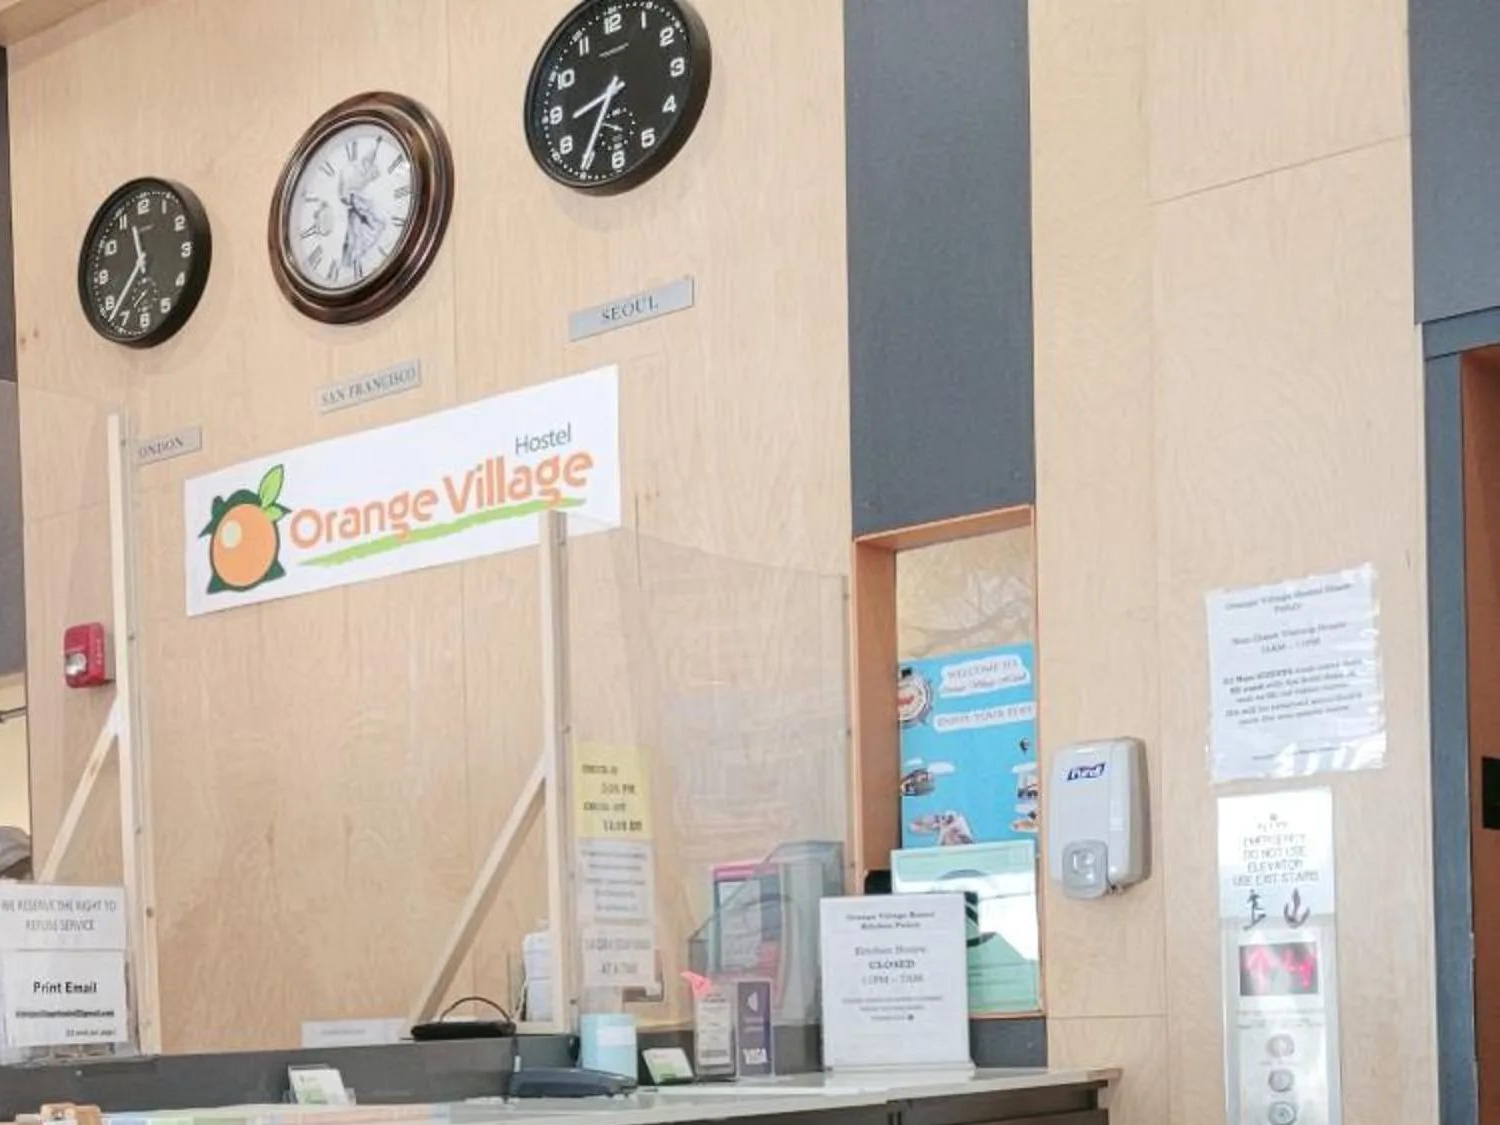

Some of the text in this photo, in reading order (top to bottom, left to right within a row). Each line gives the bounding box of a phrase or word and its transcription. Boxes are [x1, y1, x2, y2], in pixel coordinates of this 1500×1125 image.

[604, 13, 623, 35] 12
[641, 11, 647, 30] 1
[659, 26, 675, 47] 2
[579, 36, 590, 57] 11
[670, 57, 685, 77] 3
[557, 68, 575, 90] 10
[662, 95, 677, 113] 4
[550, 106, 563, 125] 9
[560, 136, 573, 154] 8
[641, 128, 655, 148] 5
[611, 151, 625, 169] 6
[137, 198, 150, 215] 12
[161, 199, 167, 214] 1
[119, 214, 128, 230] 11
[174, 214, 186, 232] 2
[104, 239, 117, 256] 10
[180, 241, 192, 258] 3
[99, 269, 109, 285] 9
[175, 272, 185, 287] 4
[104, 295, 115, 311] 8
[160, 297, 171, 314] 5
[601, 294, 659, 321] SEOUL
[119, 309, 130, 326] 7
[140, 313, 150, 328] 6
[320, 366, 417, 406] SAN FRANCISCO
[137, 434, 184, 457] ONDON
[514, 422, 573, 456] Hostel
[289, 450, 594, 550] Orange Village
[59, 919, 96, 933] SERVICE
[32, 980, 98, 995] Print Email
